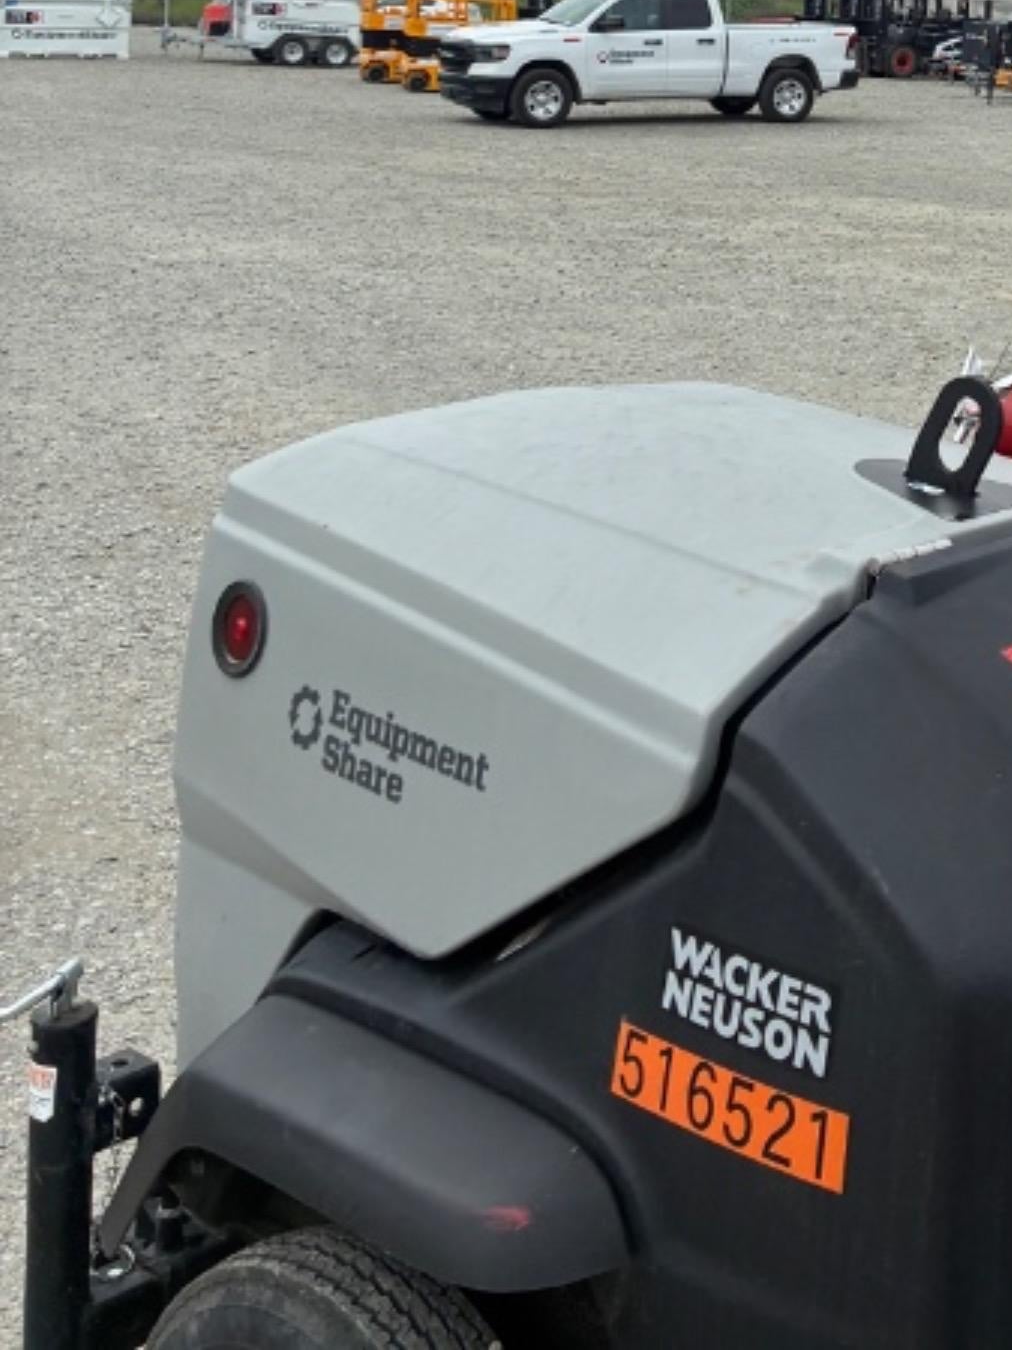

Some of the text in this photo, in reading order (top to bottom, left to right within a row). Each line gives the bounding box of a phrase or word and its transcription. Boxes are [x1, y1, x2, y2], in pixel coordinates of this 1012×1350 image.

[321, 733, 403, 804] Share
[329, 688, 490, 793] Equipment
[661, 968, 830, 1079] NEUSON
[671, 926, 832, 1033] WACKER
[620, 1028, 830, 1181] 516521
